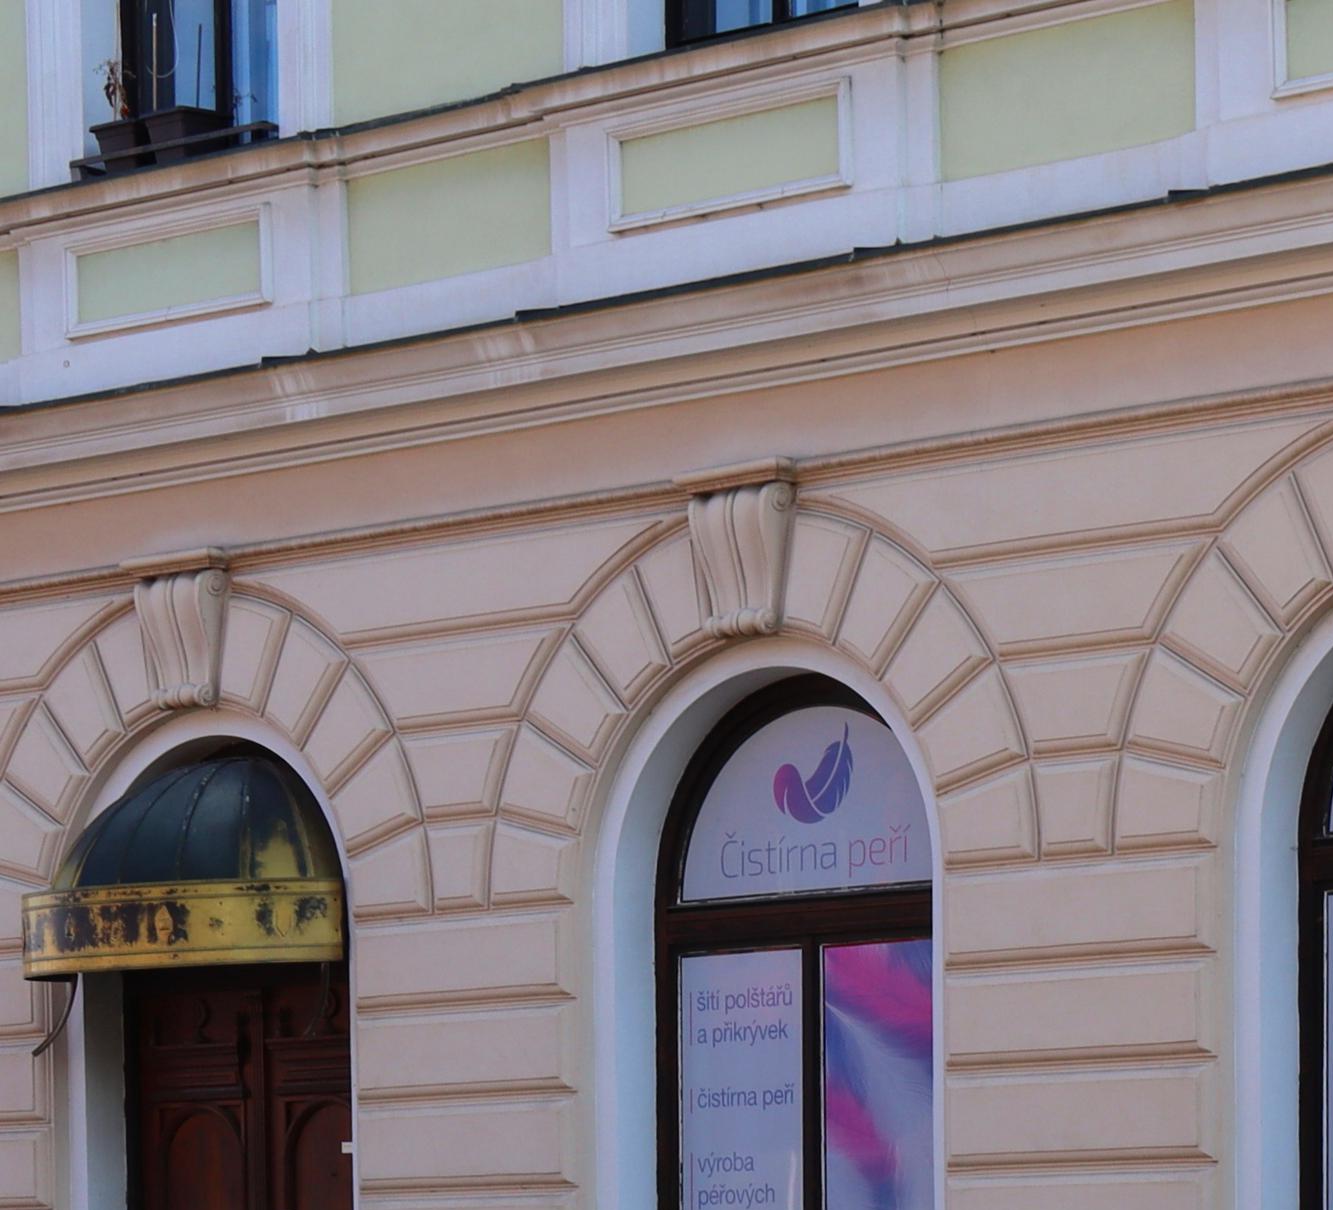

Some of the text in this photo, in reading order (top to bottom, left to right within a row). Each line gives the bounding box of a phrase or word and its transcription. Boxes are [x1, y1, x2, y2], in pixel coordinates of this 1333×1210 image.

[720, 824, 912, 879] Čistírna peří
[696, 981, 792, 1015] šití polštářů
[696, 1018, 789, 1047] a přikrývek
[696, 1083, 795, 1110] čistírna peří
[697, 1151, 755, 1178] výroba
[698, 1184, 776, 1209] péřových
